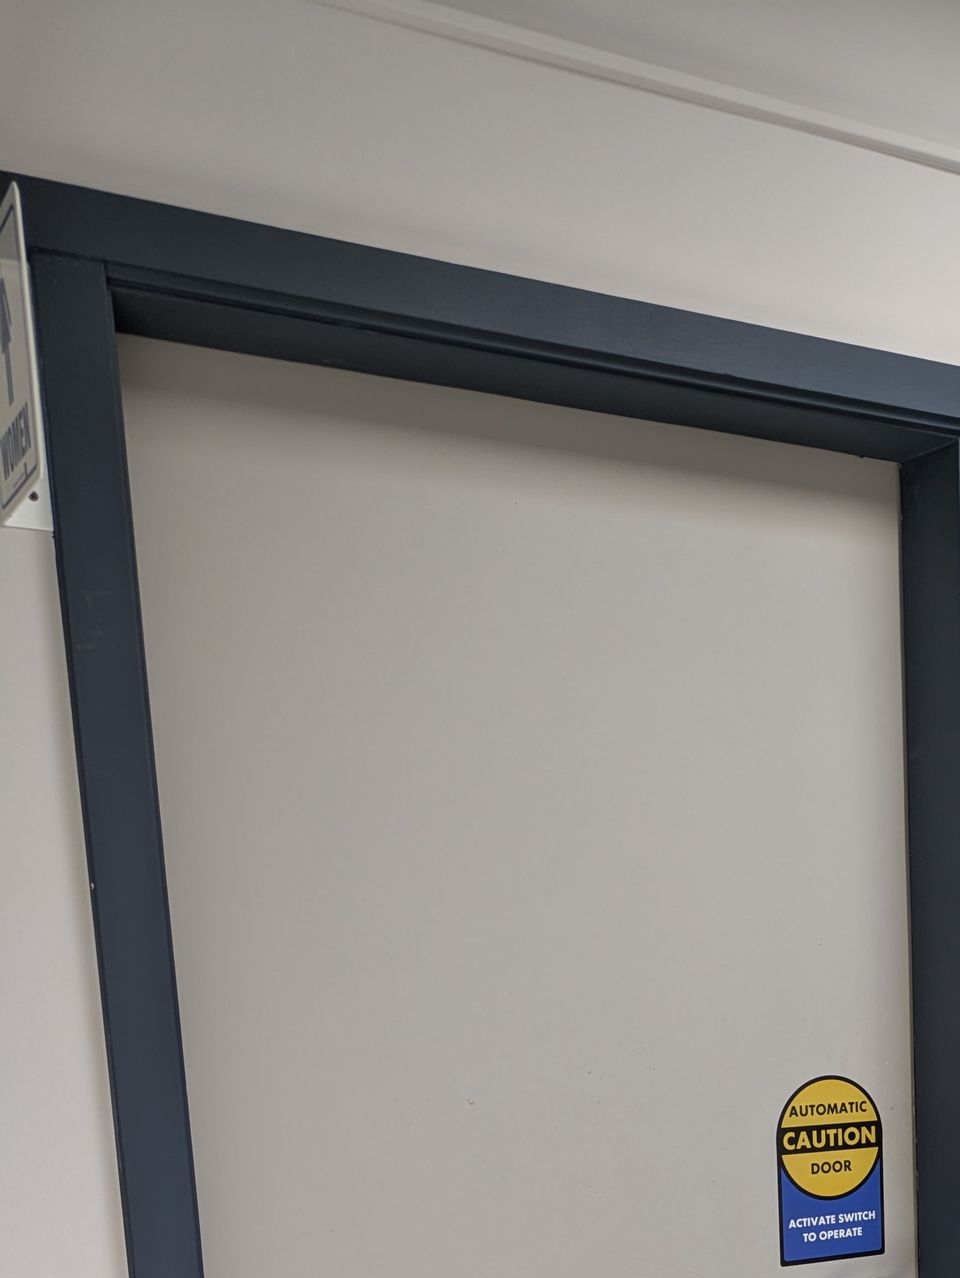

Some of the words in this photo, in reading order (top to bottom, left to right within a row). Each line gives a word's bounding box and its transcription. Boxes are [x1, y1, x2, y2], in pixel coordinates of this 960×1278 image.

[788, 1101, 868, 1118] AUTOMATIC
[783, 1125, 876, 1150] CAUTION
[811, 1160, 852, 1175] DOOR
[788, 1214, 836, 1229] ACTIVATE
[838, 1210, 876, 1224] SWITCH
[803, 1232, 817, 1242] TO
[819, 1226, 863, 1241] OPERATE
